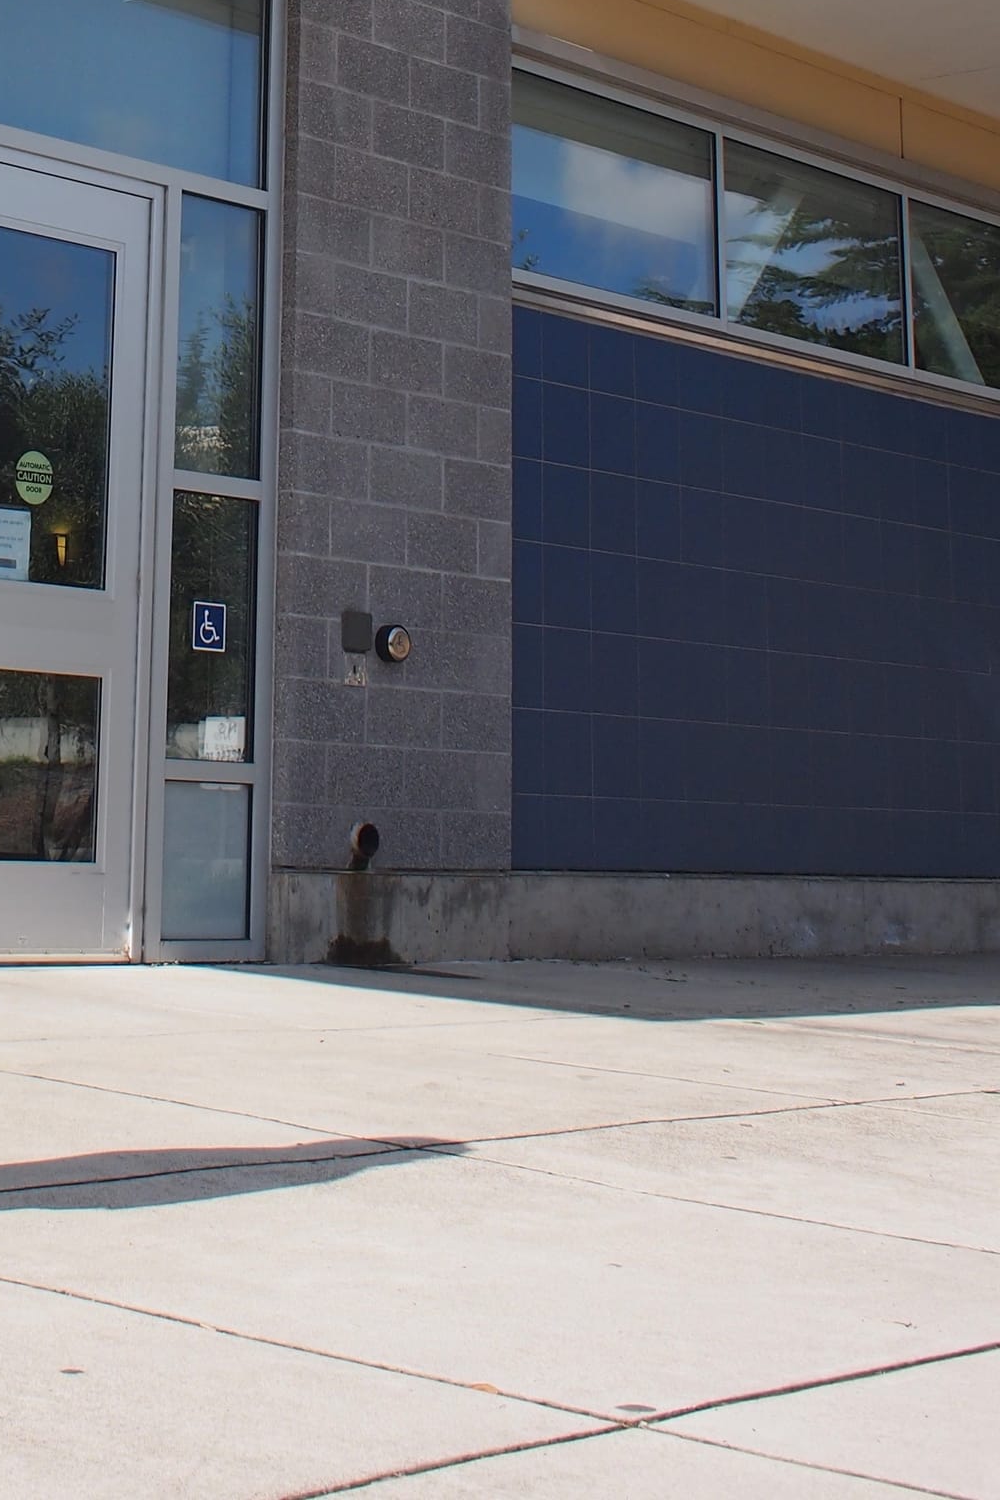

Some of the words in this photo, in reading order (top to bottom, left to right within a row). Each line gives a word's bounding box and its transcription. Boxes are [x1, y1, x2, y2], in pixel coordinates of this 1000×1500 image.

[19, 461, 50, 471] AUTOMATIC
[17, 471, 52, 484] CAUTION
[25, 485, 42, 493] DOOR
